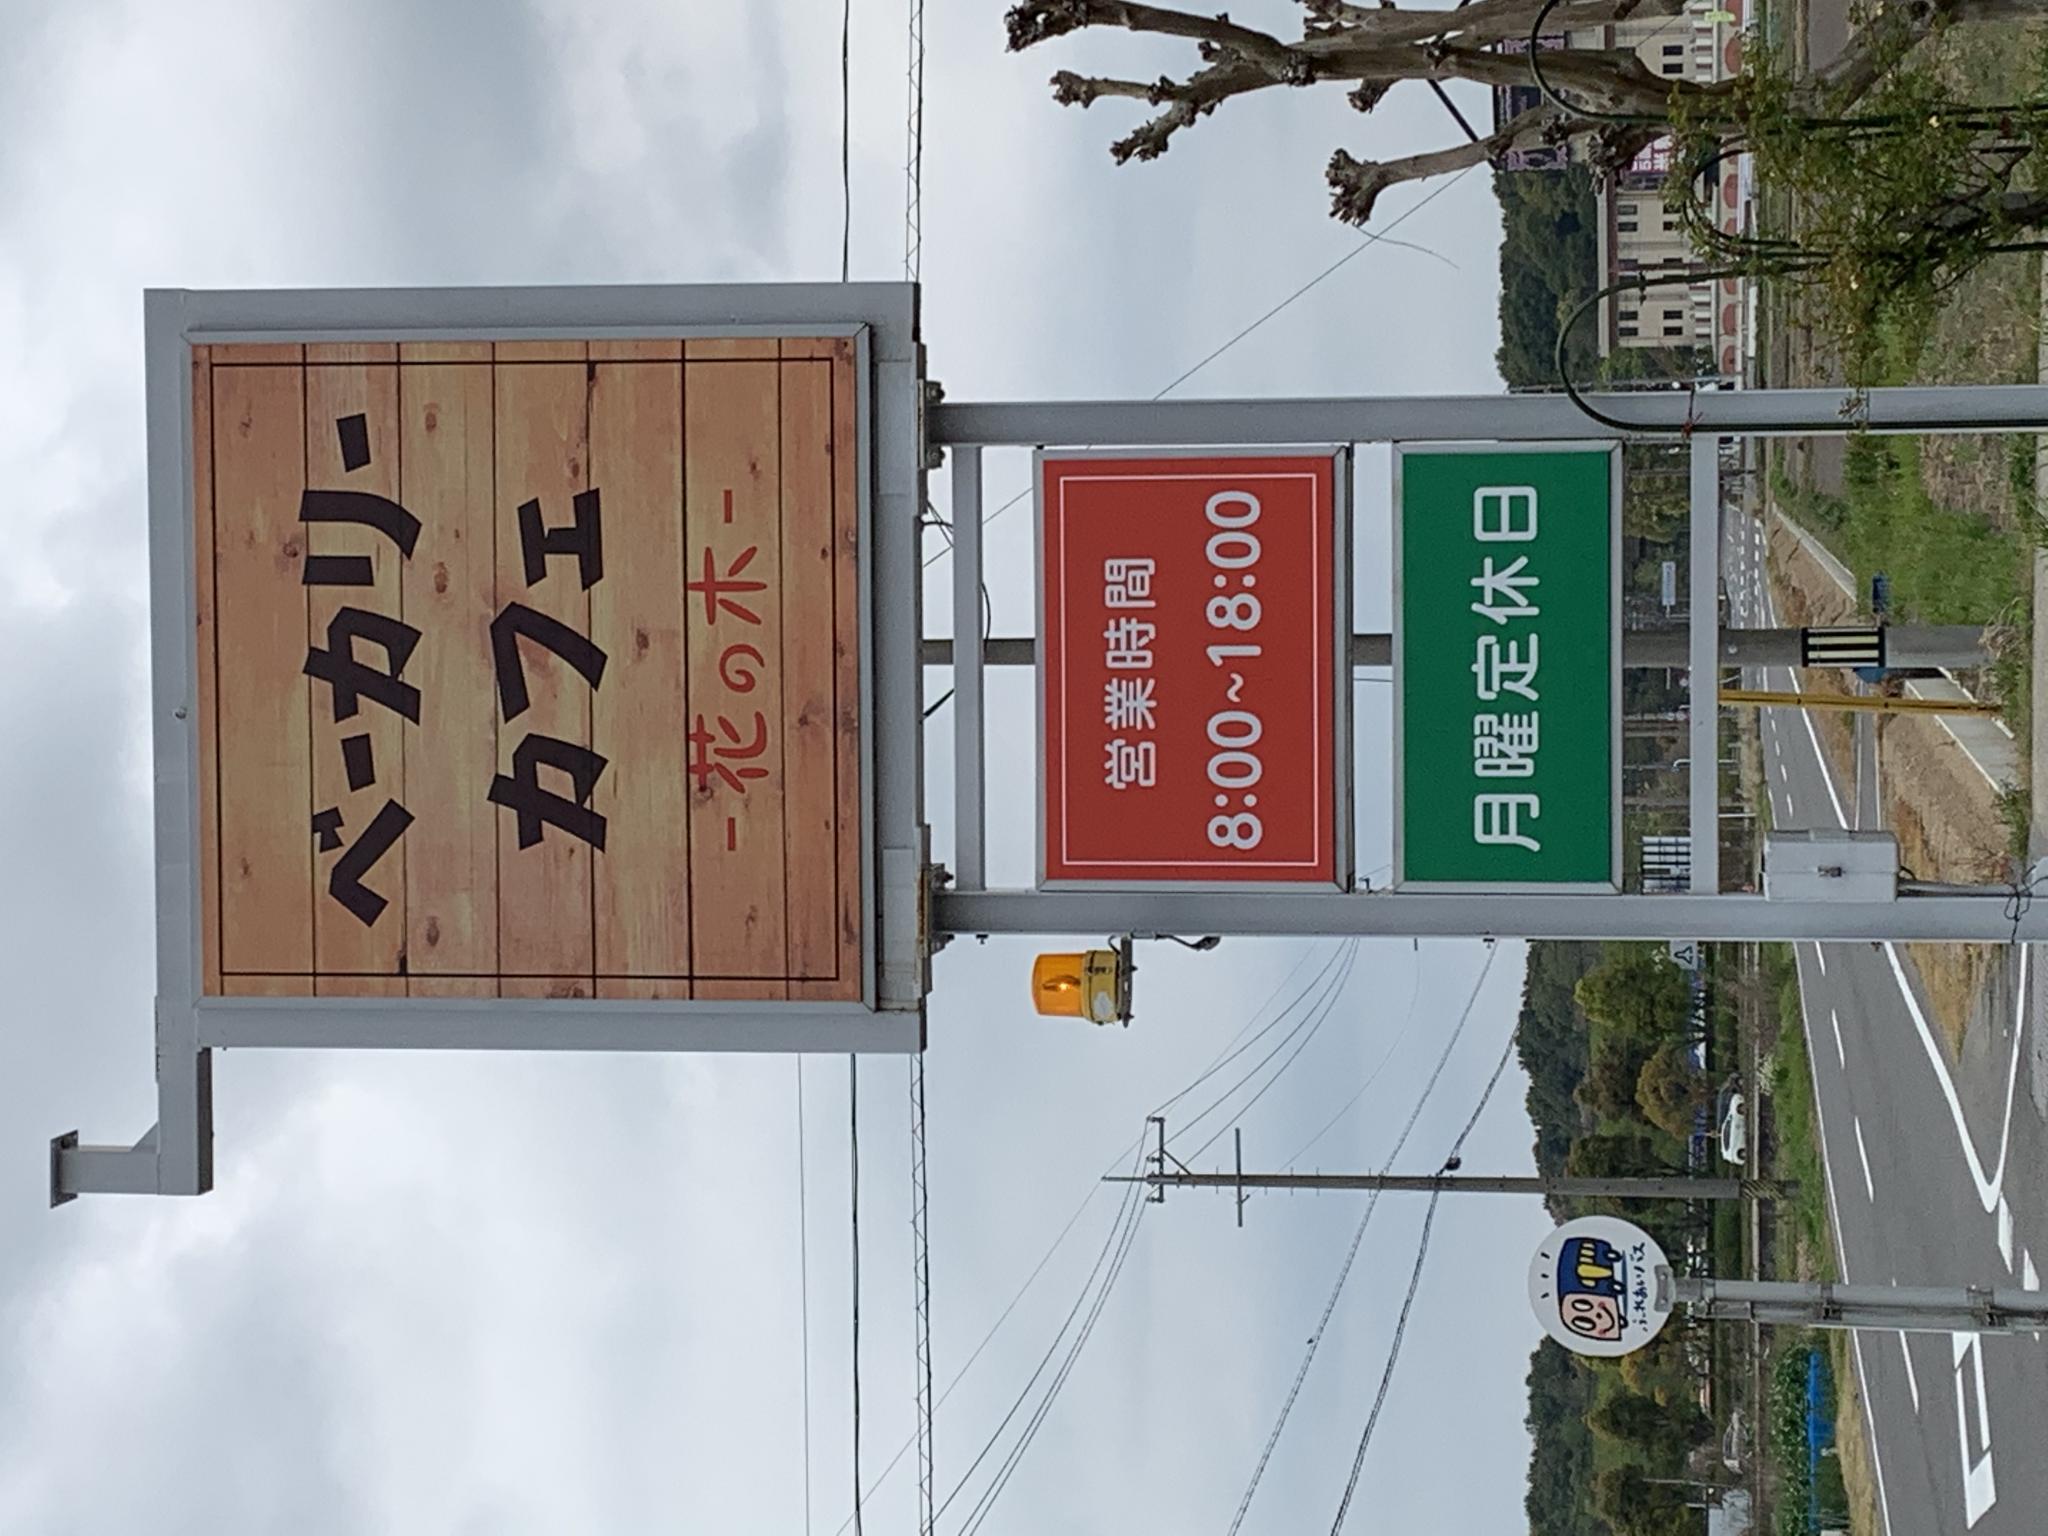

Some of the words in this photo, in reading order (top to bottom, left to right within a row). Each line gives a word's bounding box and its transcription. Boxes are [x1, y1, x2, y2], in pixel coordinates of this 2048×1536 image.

[298, 412, 422, 926] ベーカリー
[487, 487, 608, 851] カフェ
[1104, 559, 1157, 789] 営業時間
[1206, 491, 1262, 849] 8:00~18:00
[1472, 486, 1540, 851] 月曜定休日
[1629, 1241, 1648, 1333] ふれあいバス
